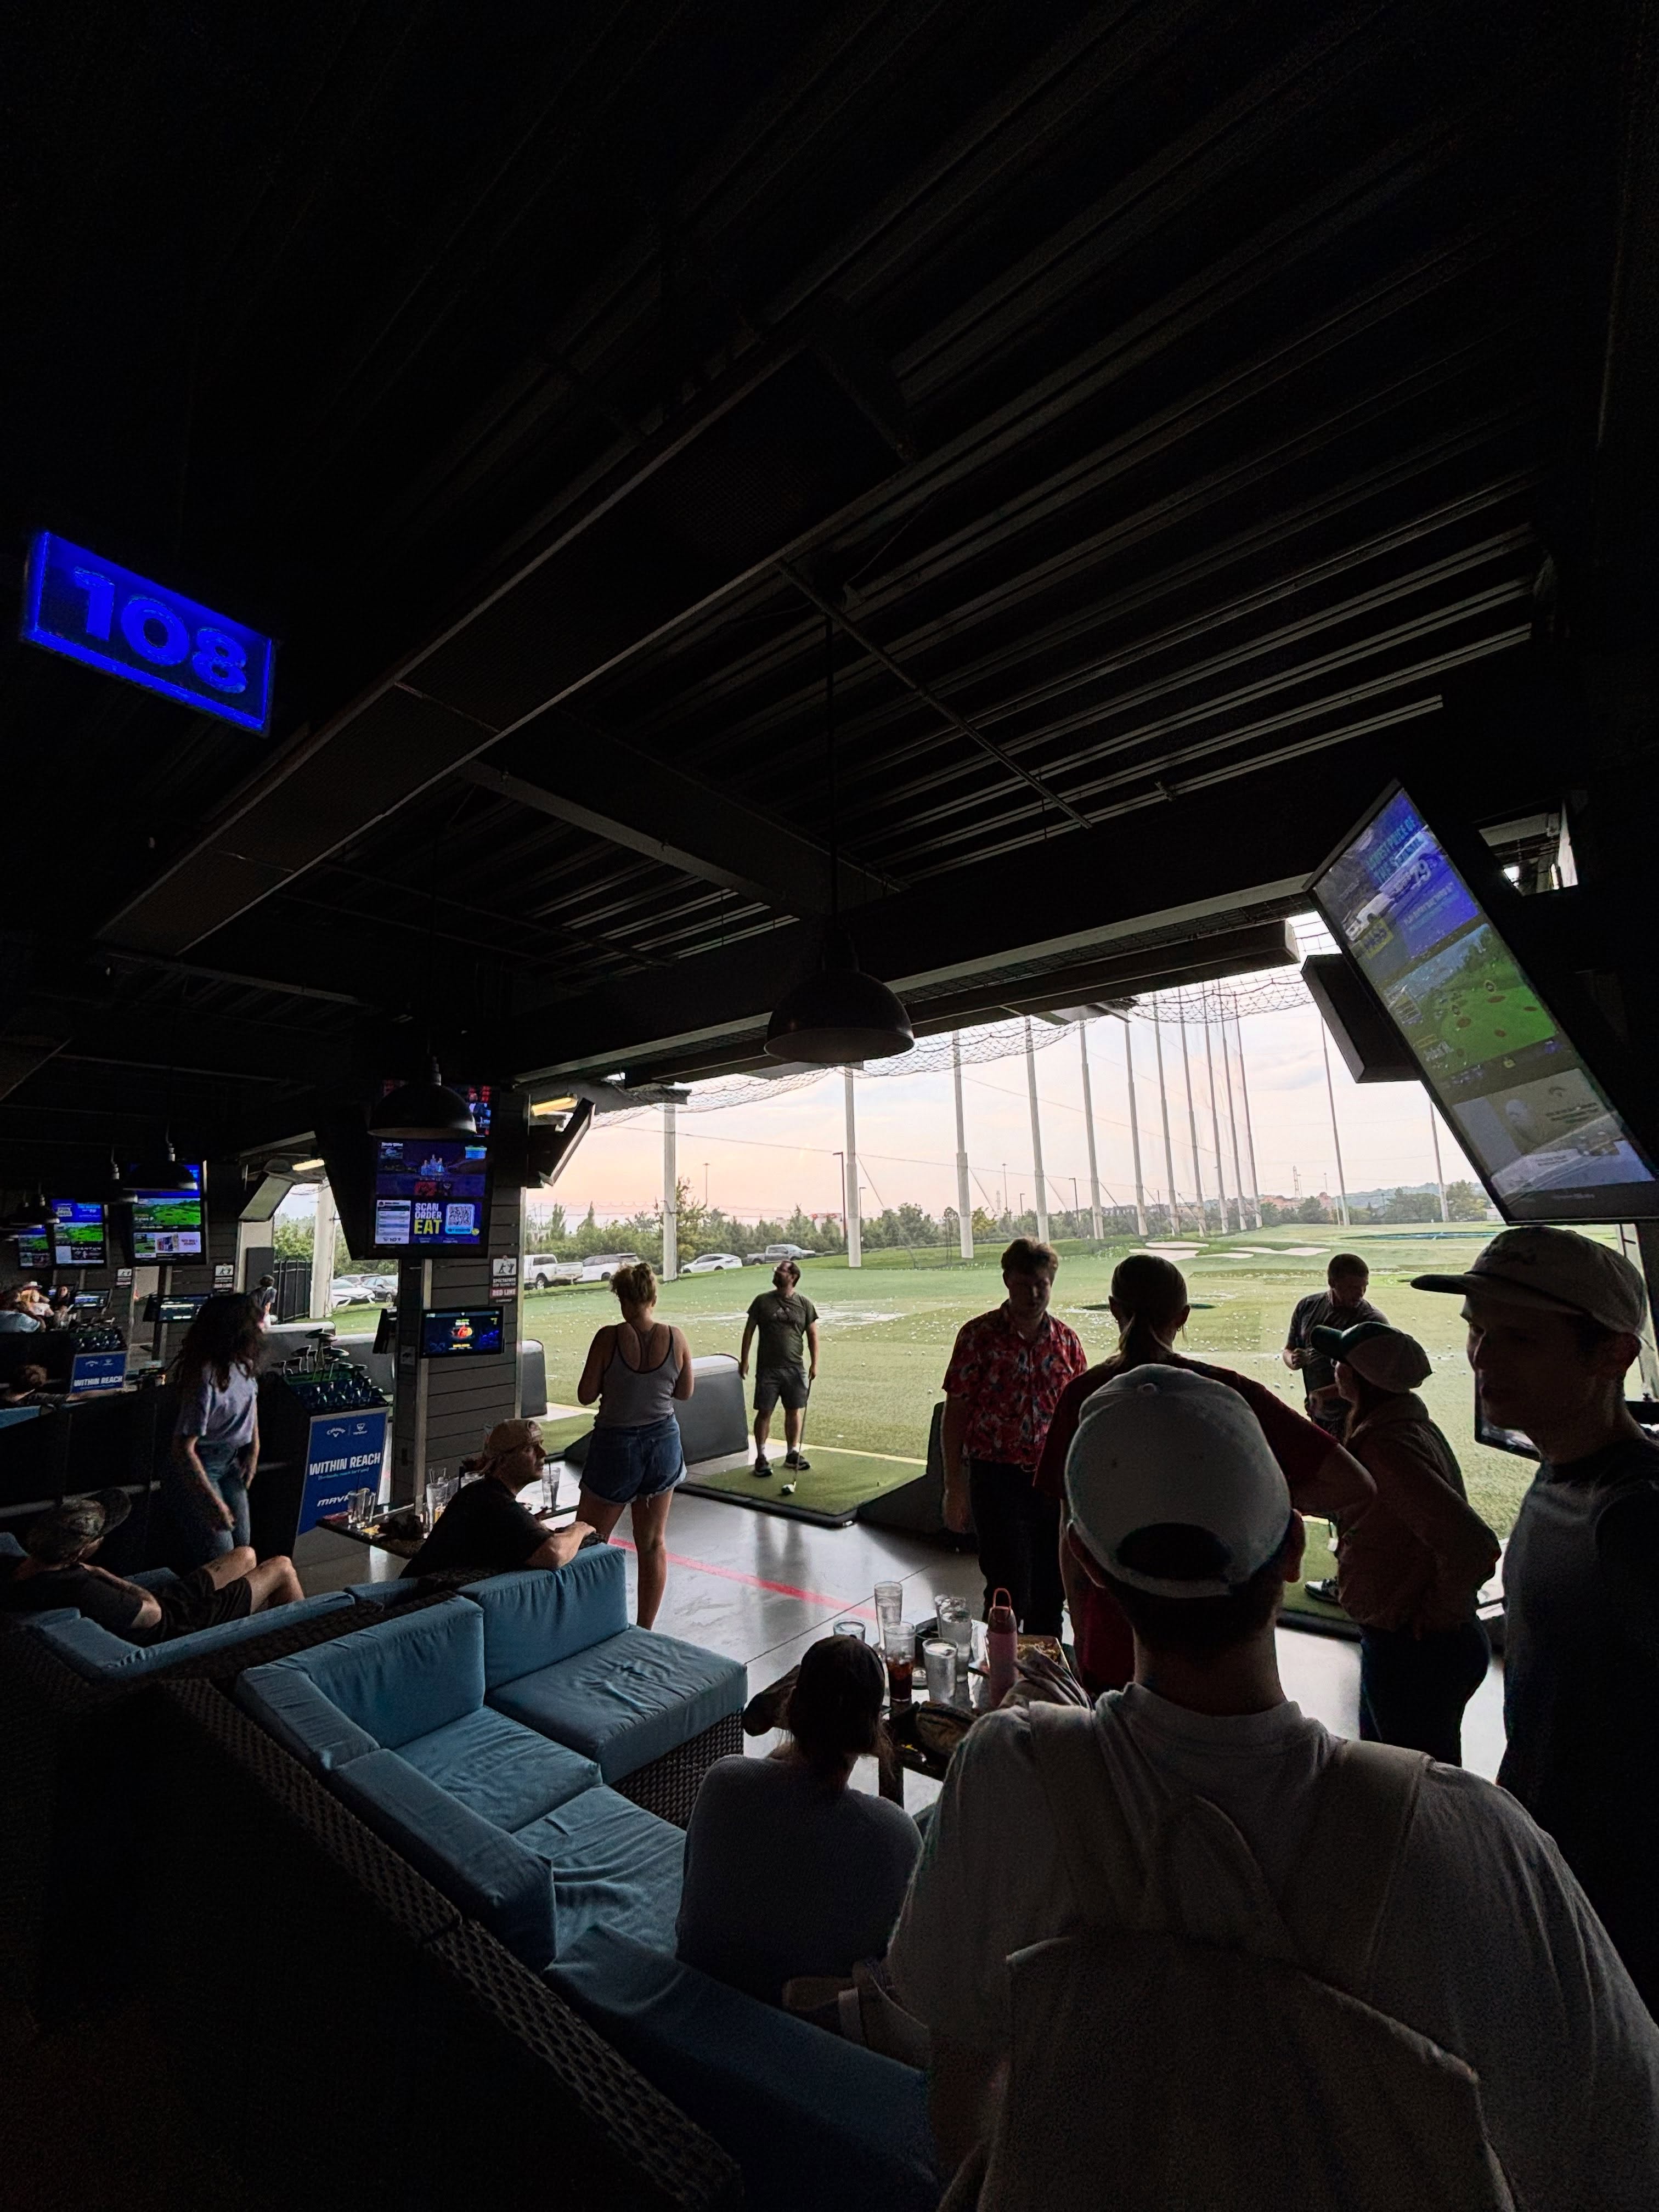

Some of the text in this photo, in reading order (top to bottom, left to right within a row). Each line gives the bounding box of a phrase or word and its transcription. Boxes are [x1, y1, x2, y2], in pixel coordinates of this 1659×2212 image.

[73, 566, 247, 693] 108
[415, 1203, 439, 1211] SCAN
[414, 1220, 443, 1234] EAT
[309, 1458, 347, 1476] WITHIN
[349, 1452, 381, 1469] REACH
